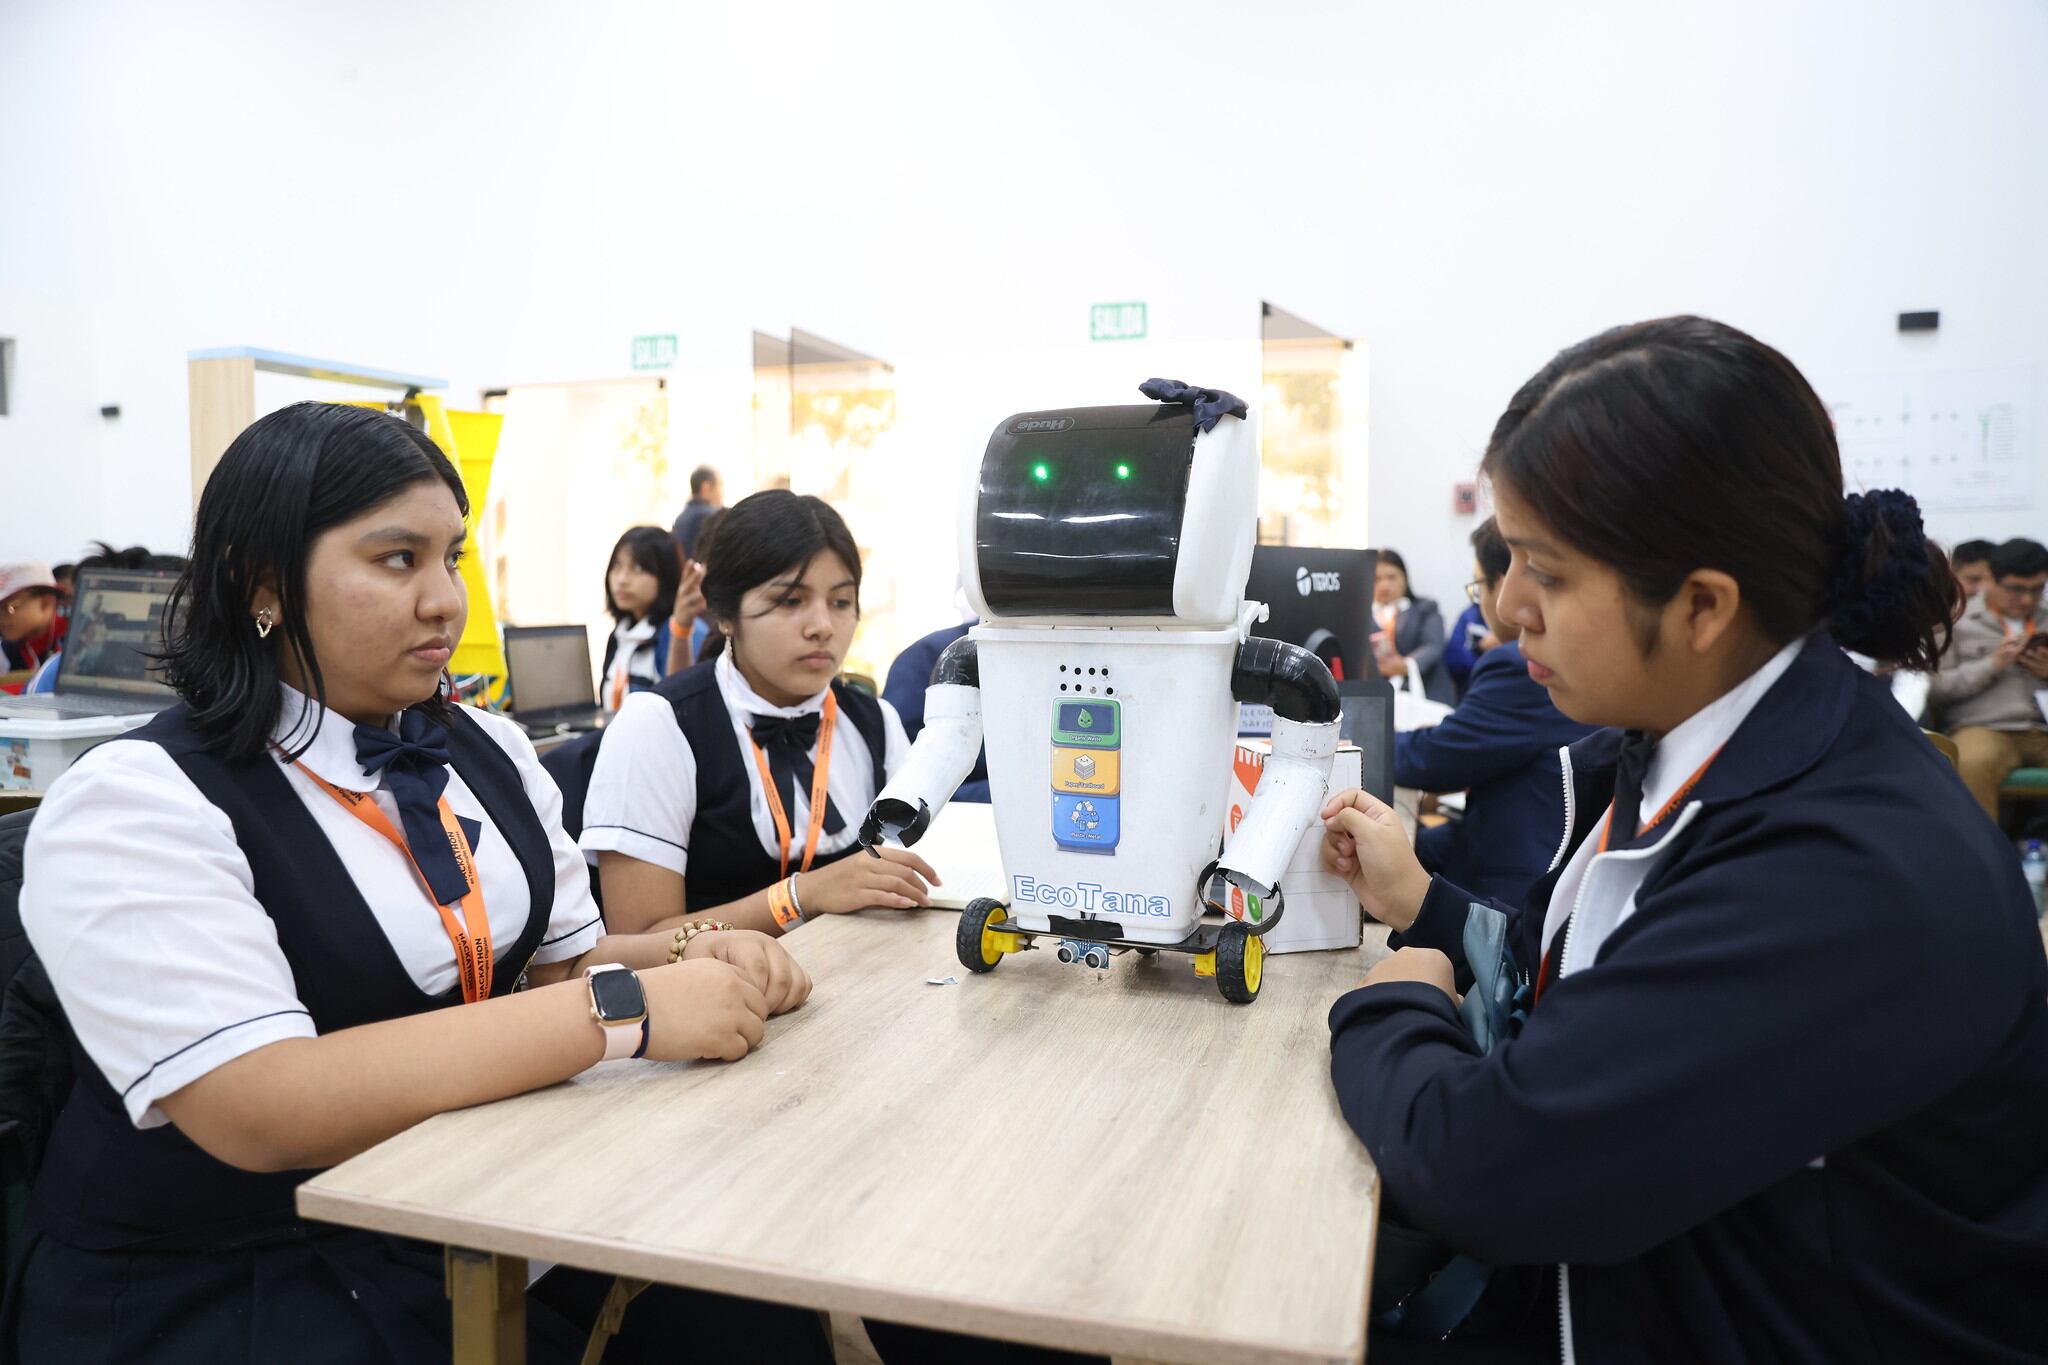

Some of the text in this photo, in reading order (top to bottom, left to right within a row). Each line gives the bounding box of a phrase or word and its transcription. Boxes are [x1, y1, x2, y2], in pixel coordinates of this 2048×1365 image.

[1094, 308, 1143, 336] SALIDA
[635, 339, 674, 366] SALIDA
[1017, 419, 1066, 432] Hude
[1013, 874, 1171, 918] EcoTana
[458, 932, 474, 992] HACKATHON
[474, 937, 485, 998] HACKATHON
